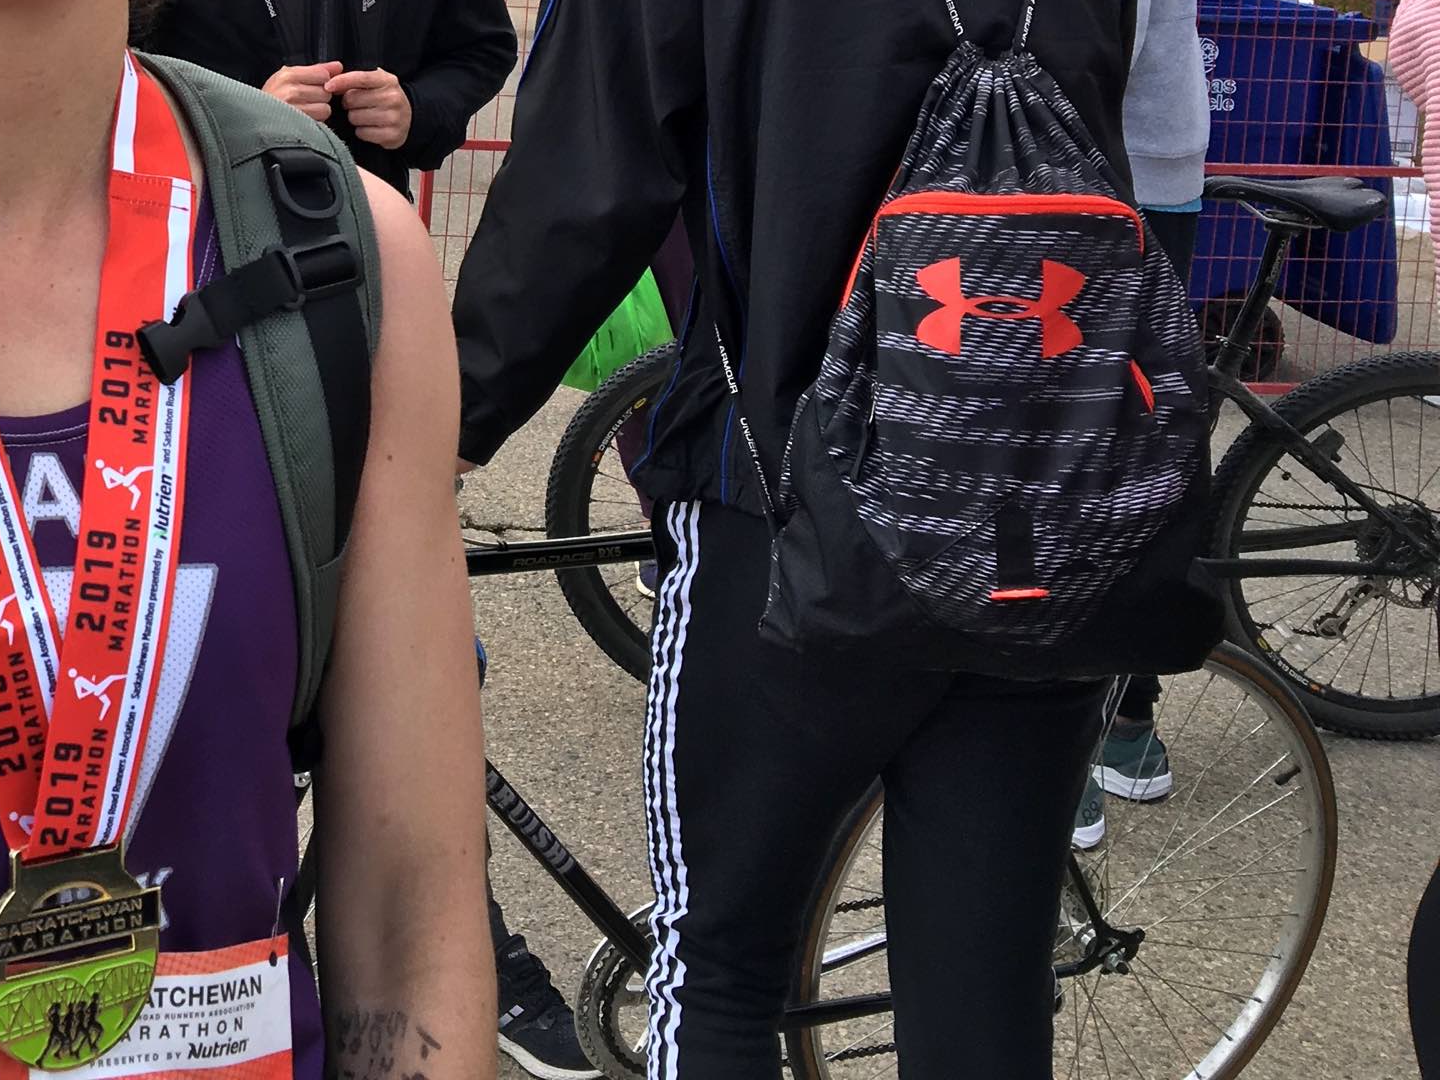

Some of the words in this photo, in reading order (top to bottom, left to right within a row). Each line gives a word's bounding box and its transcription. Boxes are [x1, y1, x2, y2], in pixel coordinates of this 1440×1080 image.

[98, 330, 134, 427] 2019
[131, 320, 155, 444] MARAT
[718, 345, 739, 395] ARMOUR
[166, 386, 176, 407] Road
[162, 408, 174, 447] Saskatoon
[163, 449, 171, 464] and
[1, 505, 17, 543] Marathon
[153, 473, 173, 541] Nutrien
[12, 544, 35, 601] Saskatchewan
[153, 548, 164, 559] by
[597, 545, 622, 560] RX5
[75, 530, 117, 633] 2019
[108, 518, 141, 652] MARATHON
[149, 560, 162, 602] presented
[32, 611, 50, 658] Association
[142, 602, 156, 641] Marathon
[131, 642, 150, 700] Saskatchewan
[119, 711, 137, 759] Association
[39, 742, 83, 847] 2019
[73, 727, 109, 843] ARATHON
[112, 759, 127, 793] Runners
[107, 793, 120, 815] Road
[485, 768, 575, 876] ARUISHI
[120, 1016, 244, 1043] ARATHON
[164, 1011, 206, 1021] RUNNERS
[209, 1001, 256, 1019] ASSOCIATION
[89, 1052, 160, 1070] PRESENTED
[166, 1051, 183, 1061] BY
[188, 1038, 249, 1060] Nutrien
